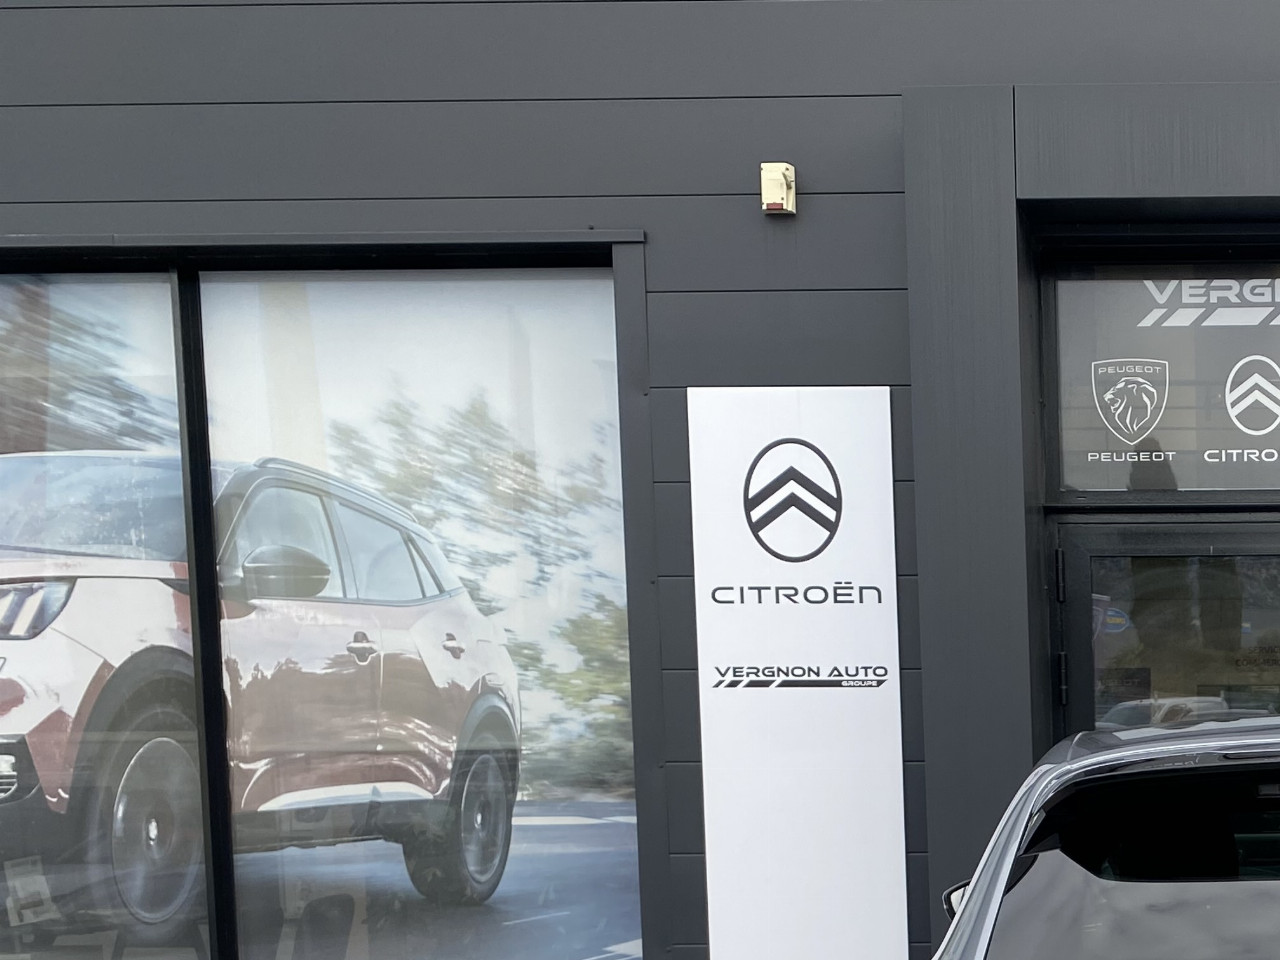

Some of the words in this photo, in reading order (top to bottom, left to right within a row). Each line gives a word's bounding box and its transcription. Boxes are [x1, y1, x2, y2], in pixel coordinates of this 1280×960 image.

[1098, 366, 1161, 375] PEUGEOT
[1088, 452, 1176, 462] PEUGEOT
[711, 582, 882, 604] CITROËN
[714, 666, 821, 678] VERGNON
[827, 666, 888, 678] AUTO
